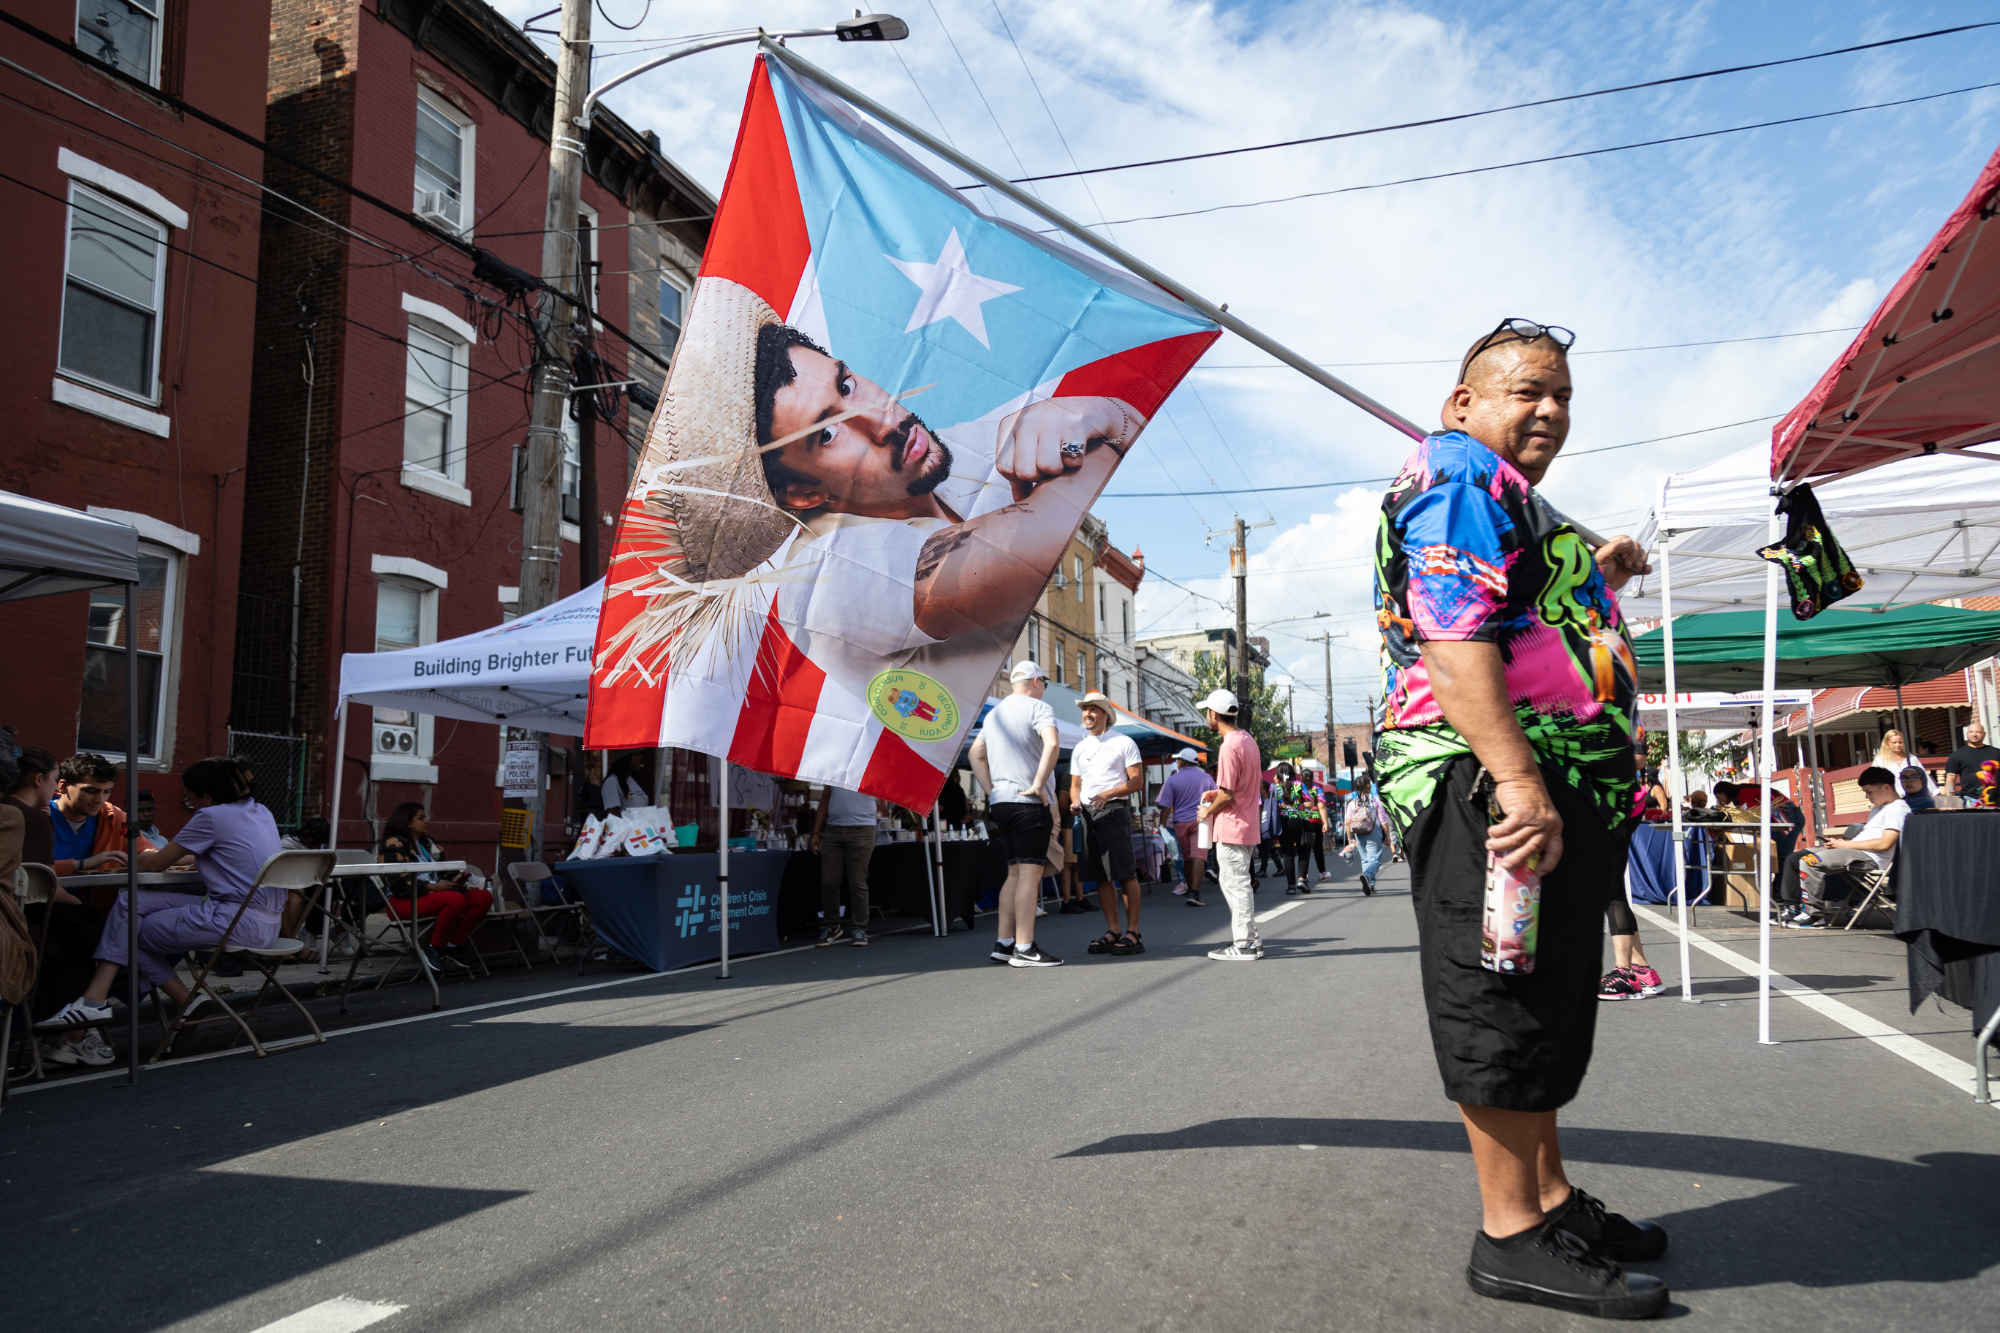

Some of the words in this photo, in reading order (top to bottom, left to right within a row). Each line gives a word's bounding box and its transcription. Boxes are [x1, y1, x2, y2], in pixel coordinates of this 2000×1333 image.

[414, 657, 481, 677] Building
[488, 651, 559, 672] Brighter
[1731, 691, 1787, 701] AMERA
[710, 891, 747, 906] Chdren's
[748, 890, 767, 902] Crisis
[709, 906, 747, 920] Trement
[748, 904, 770, 916] Center
[708, 922, 740, 932] cctcs.org
